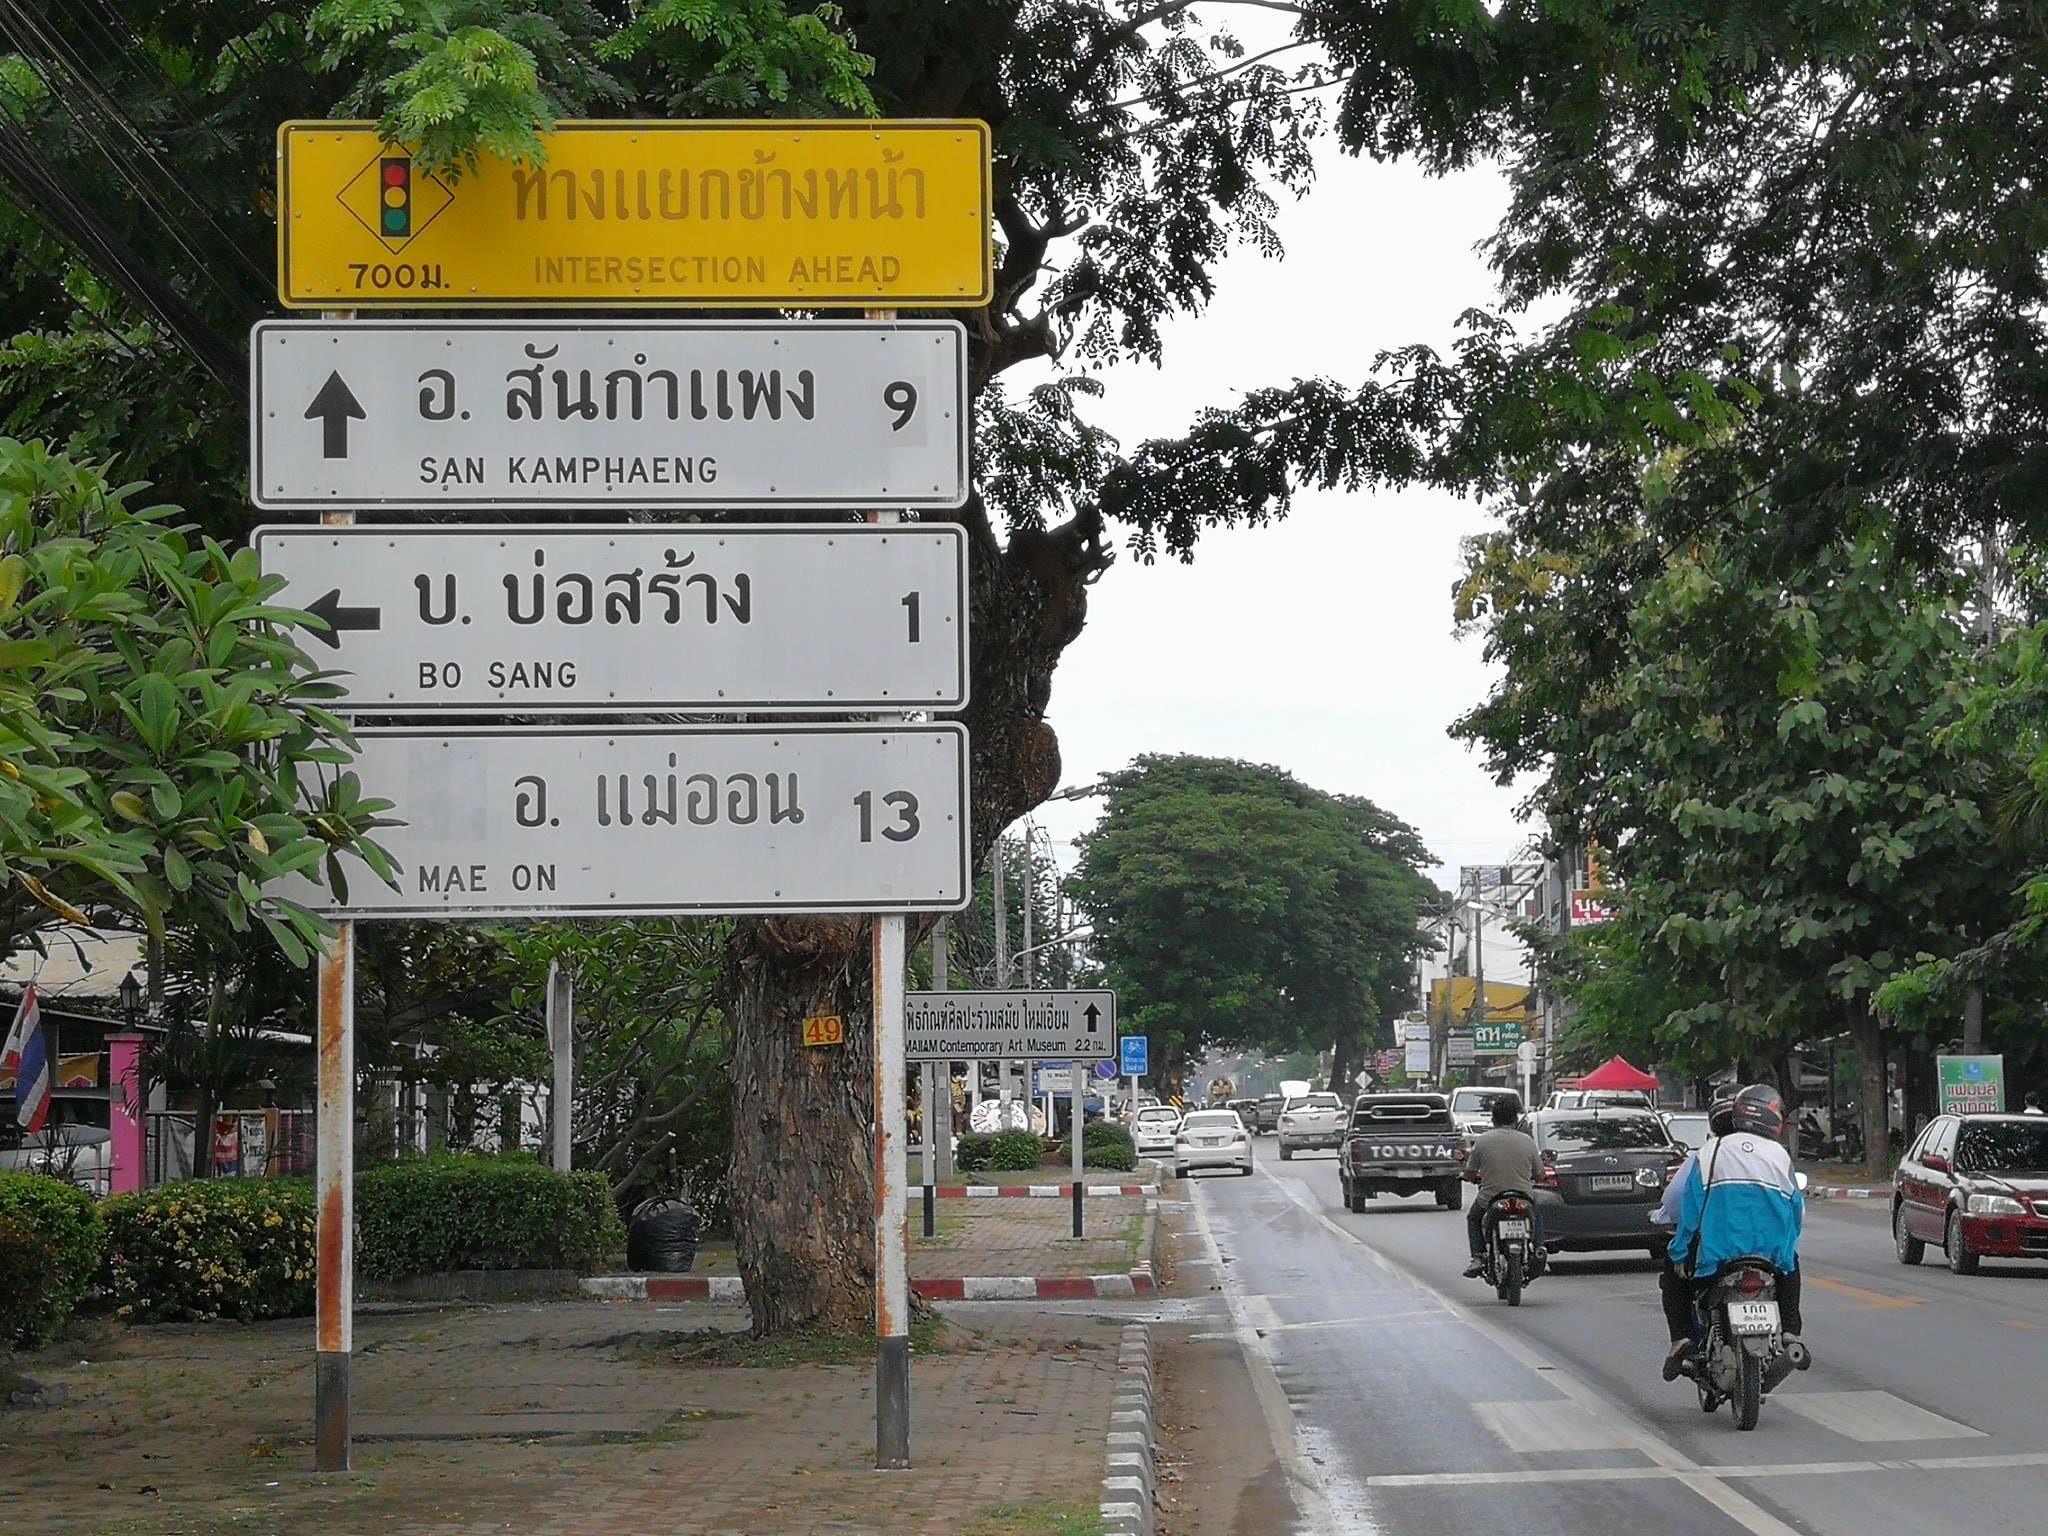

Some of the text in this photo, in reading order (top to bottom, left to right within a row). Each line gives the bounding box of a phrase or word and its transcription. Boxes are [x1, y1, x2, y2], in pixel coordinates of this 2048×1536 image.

[511, 148, 926, 221] ทางแยกข้างหน้า
[534, 255, 901, 283] INTERSECTION AHEAD
[418, 343, 917, 432] อ. สันกำแพง 9
[420, 457, 718, 484] SAN KAMPHAENG
[414, 548, 920, 643] บ. บ่อสร้าง 1
[419, 662, 577, 688] BO SANG
[514, 752, 921, 843] อ. แม่ออน 13
[419, 864, 556, 892] MAE ON
[806, 1018, 841, 1042] 49
[939, 1039, 1004, 1055] Contemporary
[1008, 1039, 1023, 1052] Art
[1027, 1039, 1066, 1053] Museum
[1370, 1144, 1447, 1158] TOYOTA
